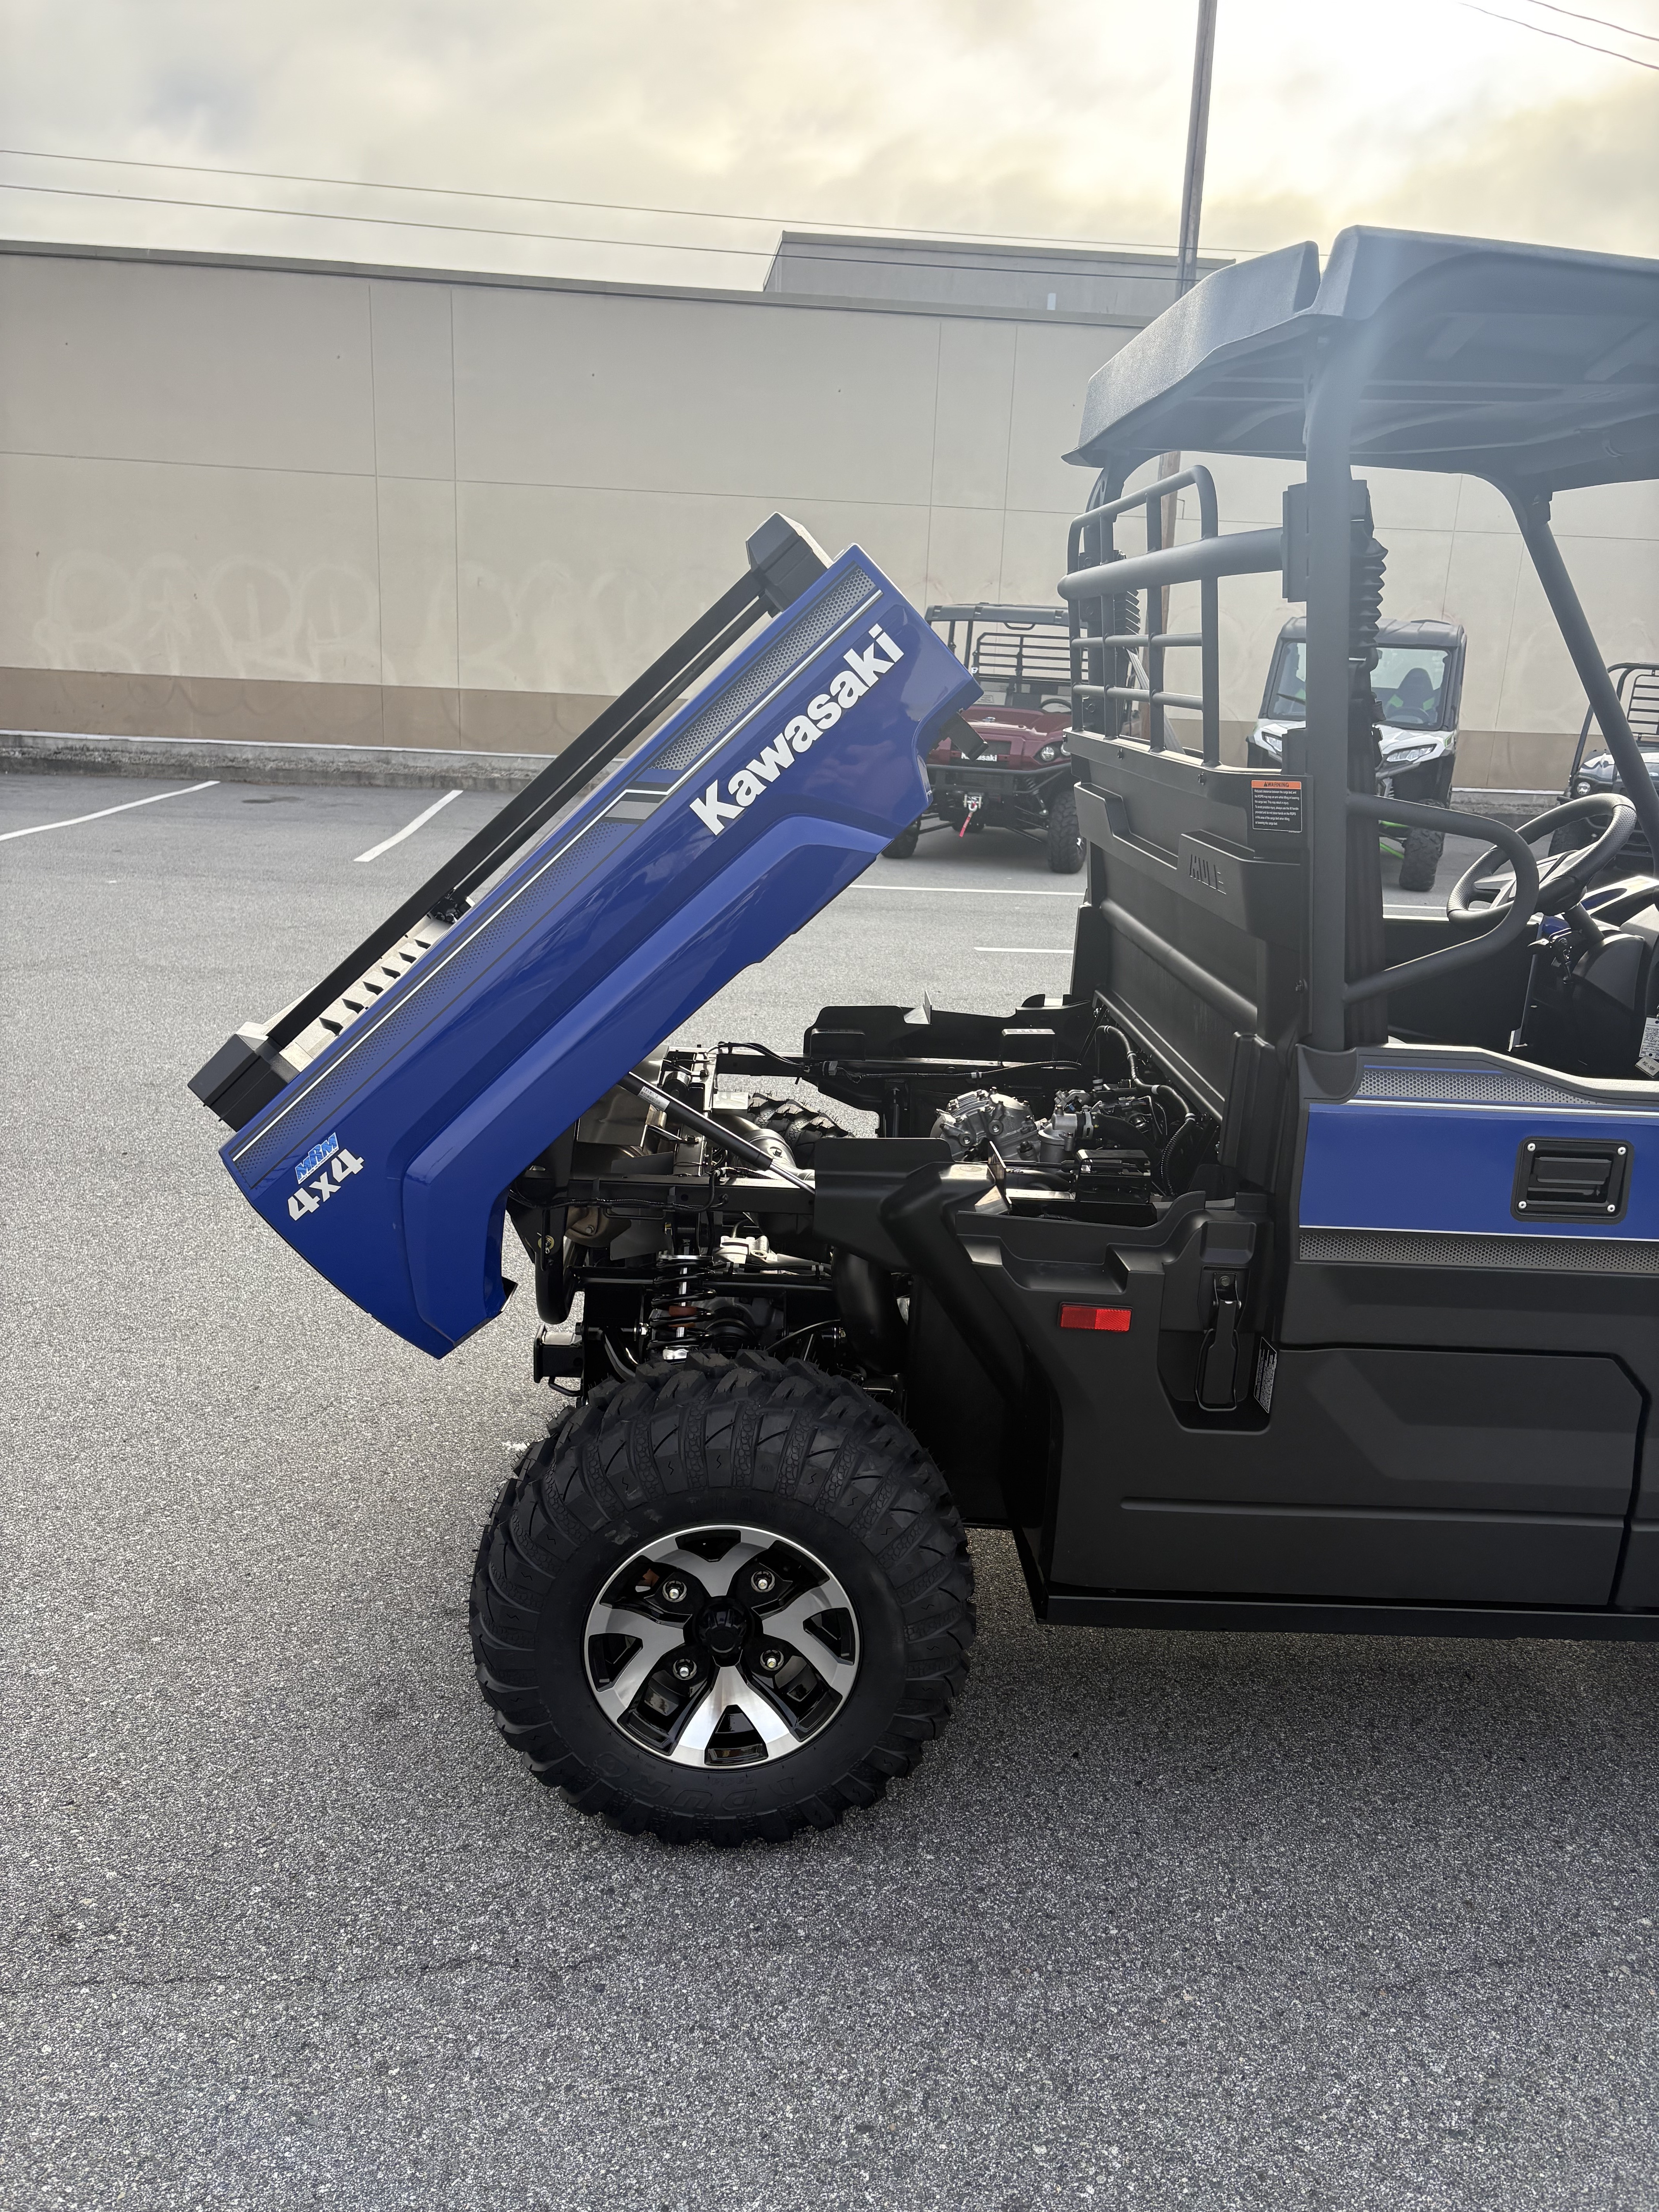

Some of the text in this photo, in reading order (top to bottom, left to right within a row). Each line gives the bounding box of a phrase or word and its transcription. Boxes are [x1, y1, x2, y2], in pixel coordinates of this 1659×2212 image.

[689, 623, 904, 835] Kawasaki
[961, 752, 997, 761] Kasaki
[1190, 854, 1226, 895] MULE
[295, 1132, 338, 1181] MRM
[593, 1752, 757, 1811] DURO
